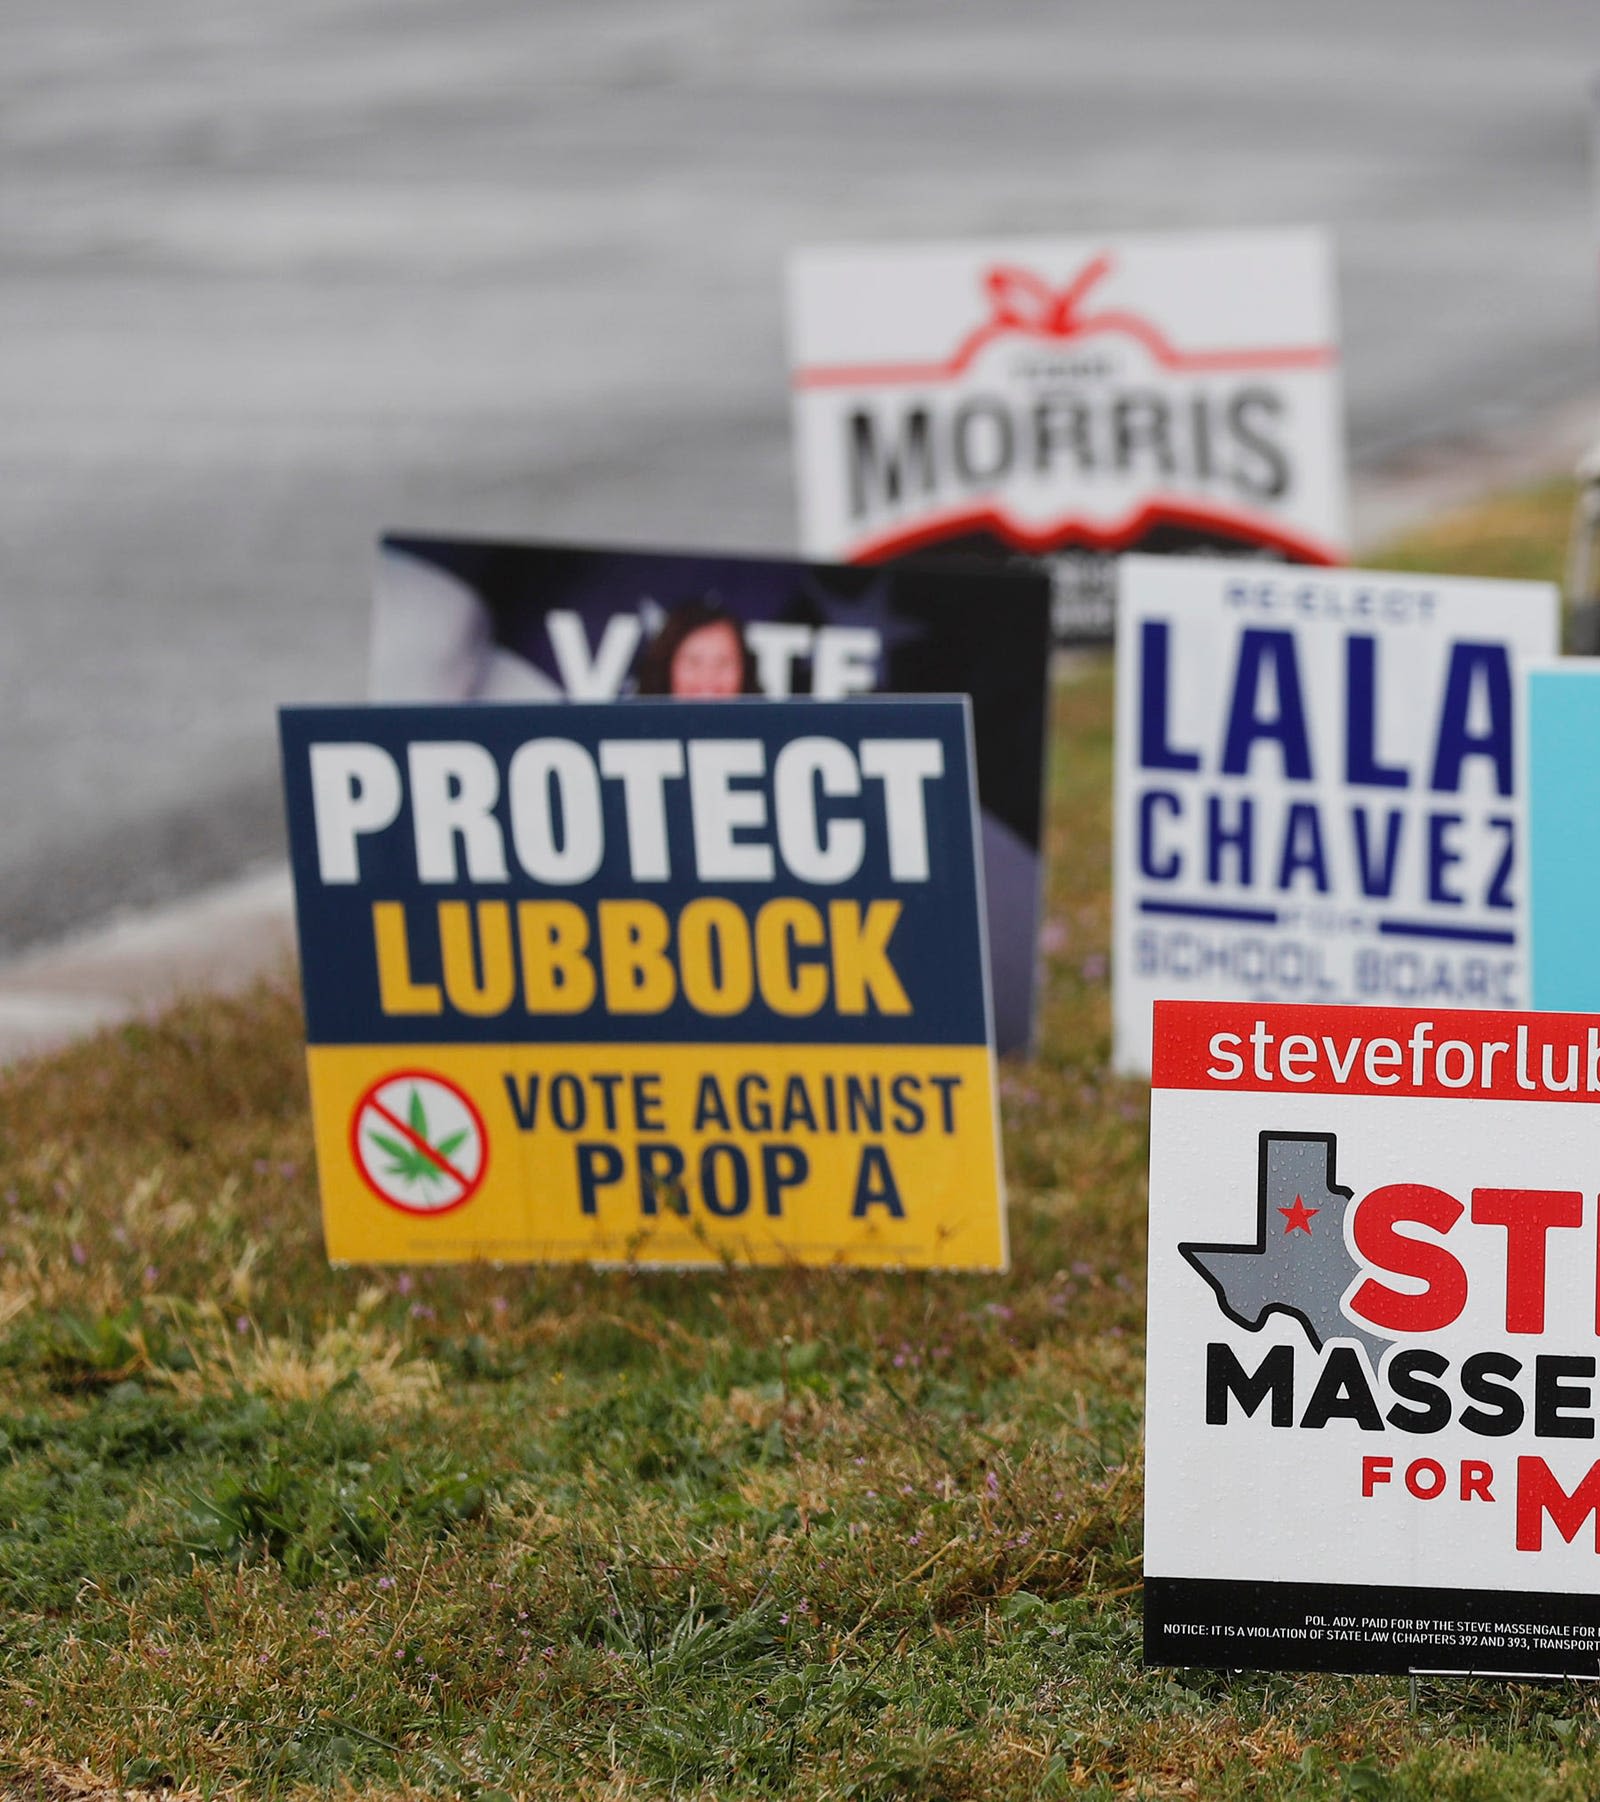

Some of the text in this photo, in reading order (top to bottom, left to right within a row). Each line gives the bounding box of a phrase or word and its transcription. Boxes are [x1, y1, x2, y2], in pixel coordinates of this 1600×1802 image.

[846, 388, 1290, 514] MORRIS
[1224, 578, 1438, 620] RE-ELECT
[547, 611, 883, 699] VTE
[1138, 618, 1514, 798] LALA
[309, 736, 944, 885] PROTECT
[1138, 791, 1514, 910] CHAVEZ
[373, 898, 912, 1016] LUBBOCK
[501, 1070, 964, 1138] VOTE AGAINST
[575, 1142, 908, 1221] PROP A
[1361, 1455, 1496, 1503] FOR
[1163, 1622, 1209, 1636] NOTICE:
[1211, 1624, 1221, 1636] IT
[1224, 1624, 1235, 1637] IS
[1237, 1625, 1245, 1637] A
[1246, 1625, 1307, 1640] VIOLATION
[1309, 1628, 1324, 1641] OF
[1326, 1629, 1361, 1642] STATE
[1364, 1630, 1389, 1643] LAW
[1392, 1631, 1456, 1648] (CHAPTERS
[1458, 1634, 1478, 1647] 392
[1480, 1635, 1504, 1648] AND
[1507, 1636, 1530, 1651] 393,
[1305, 1614, 1330, 1627] POL.
[1332, 1615, 1359, 1628] ADV.
[1361, 1616, 1388, 1629] PAID
[1391, 1618, 1413, 1630] FOR
[1416, 1619, 1430, 1631] BY
[1432, 1619, 1454, 1632] THE
[1457, 1620, 1492, 1634] STEVE
[1494, 1622, 1570, 1637] MASSENGALE
[1573, 1625, 1595, 1638] FOR
